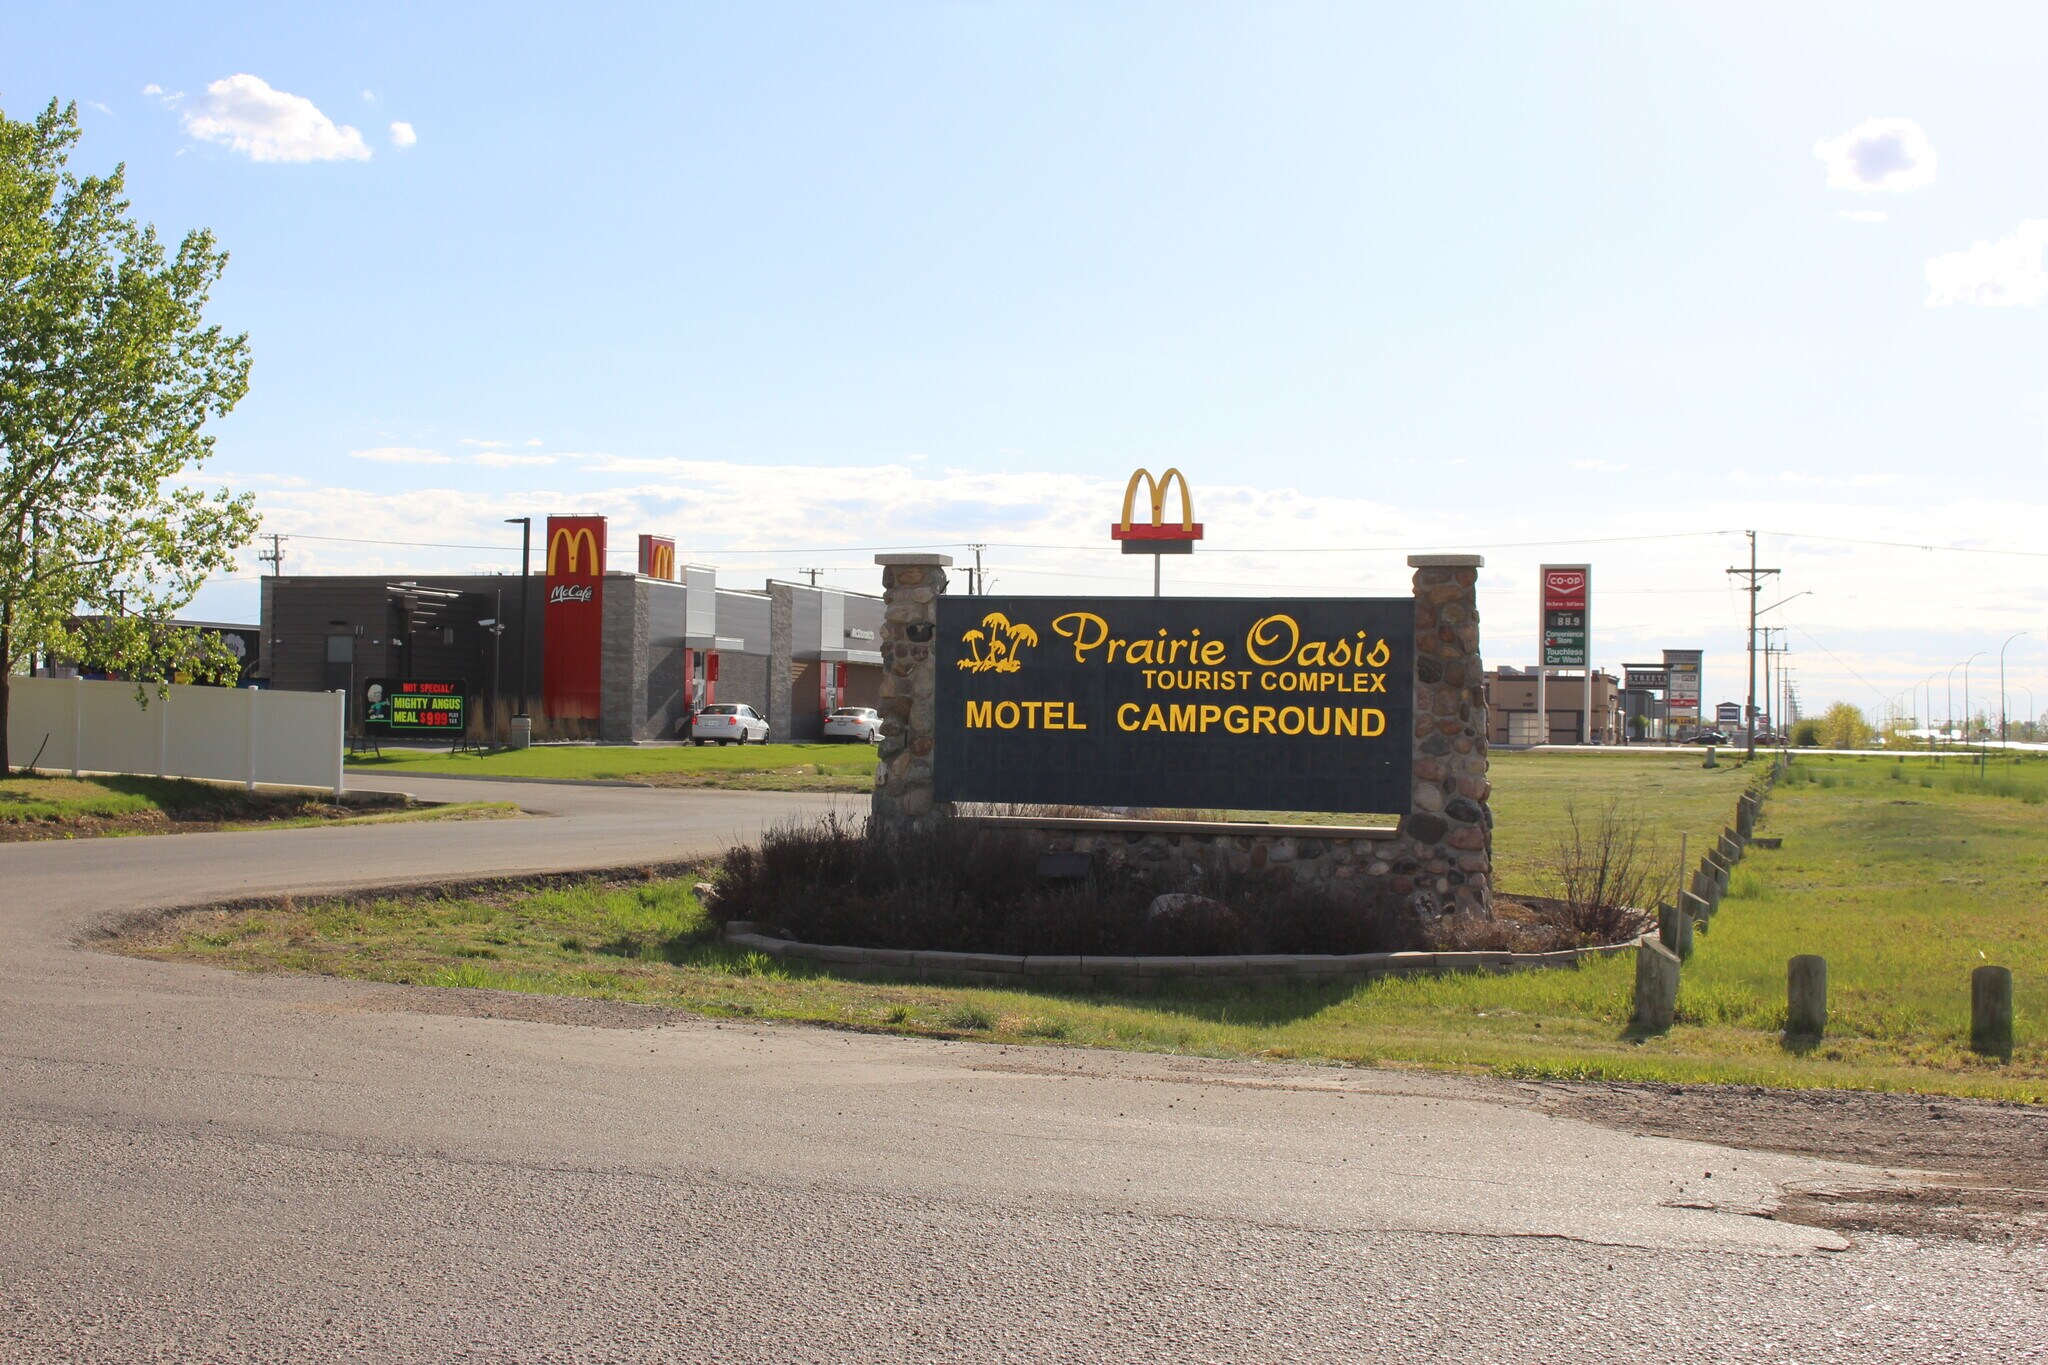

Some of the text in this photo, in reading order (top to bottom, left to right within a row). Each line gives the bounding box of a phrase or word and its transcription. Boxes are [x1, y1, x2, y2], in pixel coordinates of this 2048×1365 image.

[550, 584, 593, 603] McCafé
[1557, 617, 1580, 626] 88.9
[1052, 612, 1390, 667] Prairie Oasis
[1546, 647, 1584, 656] Touchless
[1562, 656, 1583, 664] Wash
[1142, 669, 1387, 693] TOURIST COMPLEX
[403, 683, 454, 693] HOT SPECIAL!
[394, 697, 461, 710] MIGHTY ANGUS
[394, 711, 418, 723] MEAL
[966, 701, 1386, 736] MOTEL CAMPGROUND
